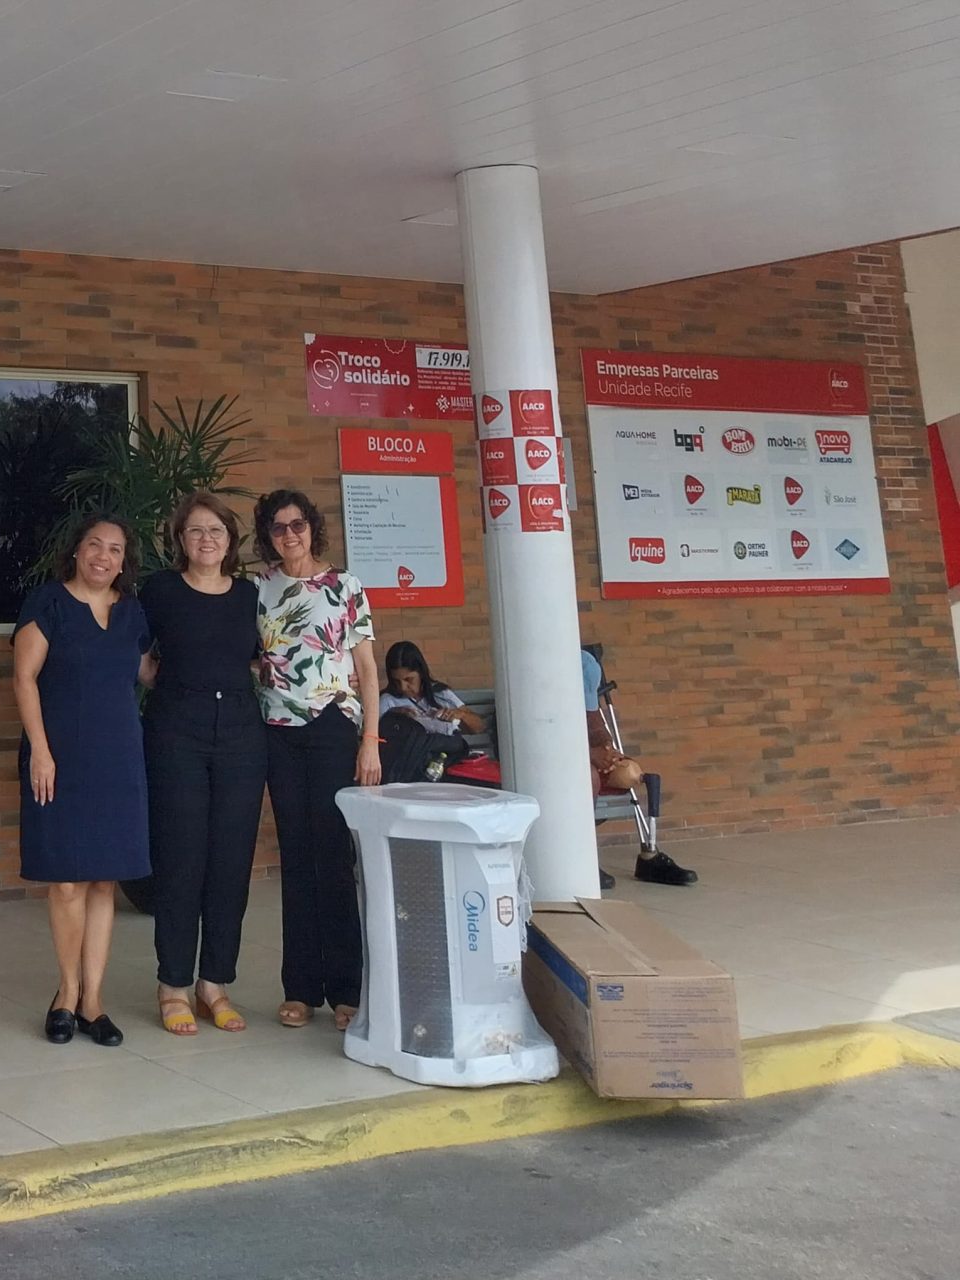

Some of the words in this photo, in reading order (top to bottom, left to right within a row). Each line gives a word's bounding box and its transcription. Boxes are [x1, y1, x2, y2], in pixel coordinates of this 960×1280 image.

[337, 351, 381, 368] Troco
[596, 360, 660, 378] Empresas
[663, 366, 720, 380] Parceiras
[344, 369, 410, 386] solidário
[598, 380, 652, 396] Unidade
[654, 382, 693, 398] Recife
[522, 402, 545, 410] AACD
[724, 430, 746, 444] BOM
[368, 436, 413, 453] BLOCO
[416, 438, 426, 454] A
[528, 450, 550, 458] AACD
[686, 485, 703, 493] AACD
[786, 486, 802, 494] AACD
[532, 498, 554, 506] AACD
[792, 540, 808, 548] AACD
[465, 897, 483, 952] Midea
